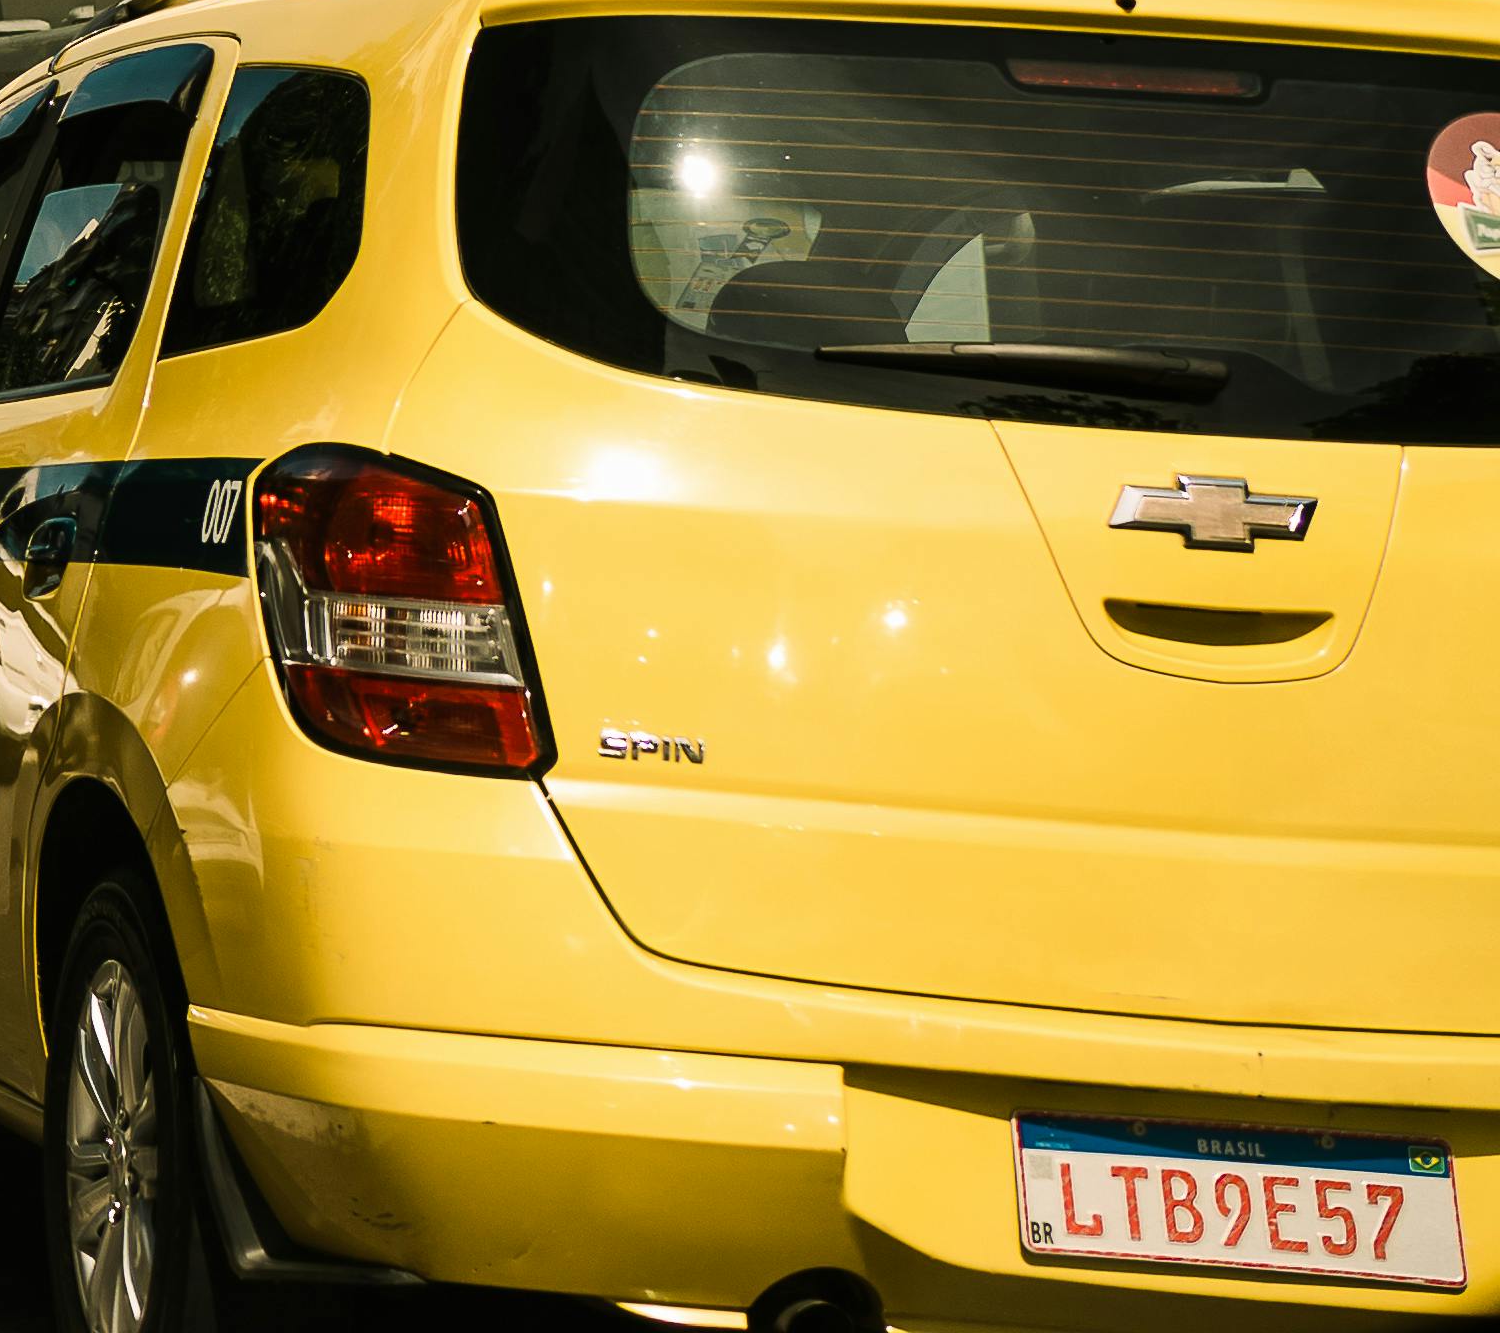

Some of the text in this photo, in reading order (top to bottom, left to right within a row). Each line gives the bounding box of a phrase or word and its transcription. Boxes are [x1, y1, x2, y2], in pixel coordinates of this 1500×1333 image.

[598, 731, 705, 765] SPIN
[1196, 1138, 1266, 1158] BRASIL
[1060, 1162, 1404, 1261] LTB9E57
[1031, 1221, 1055, 1245] BR
